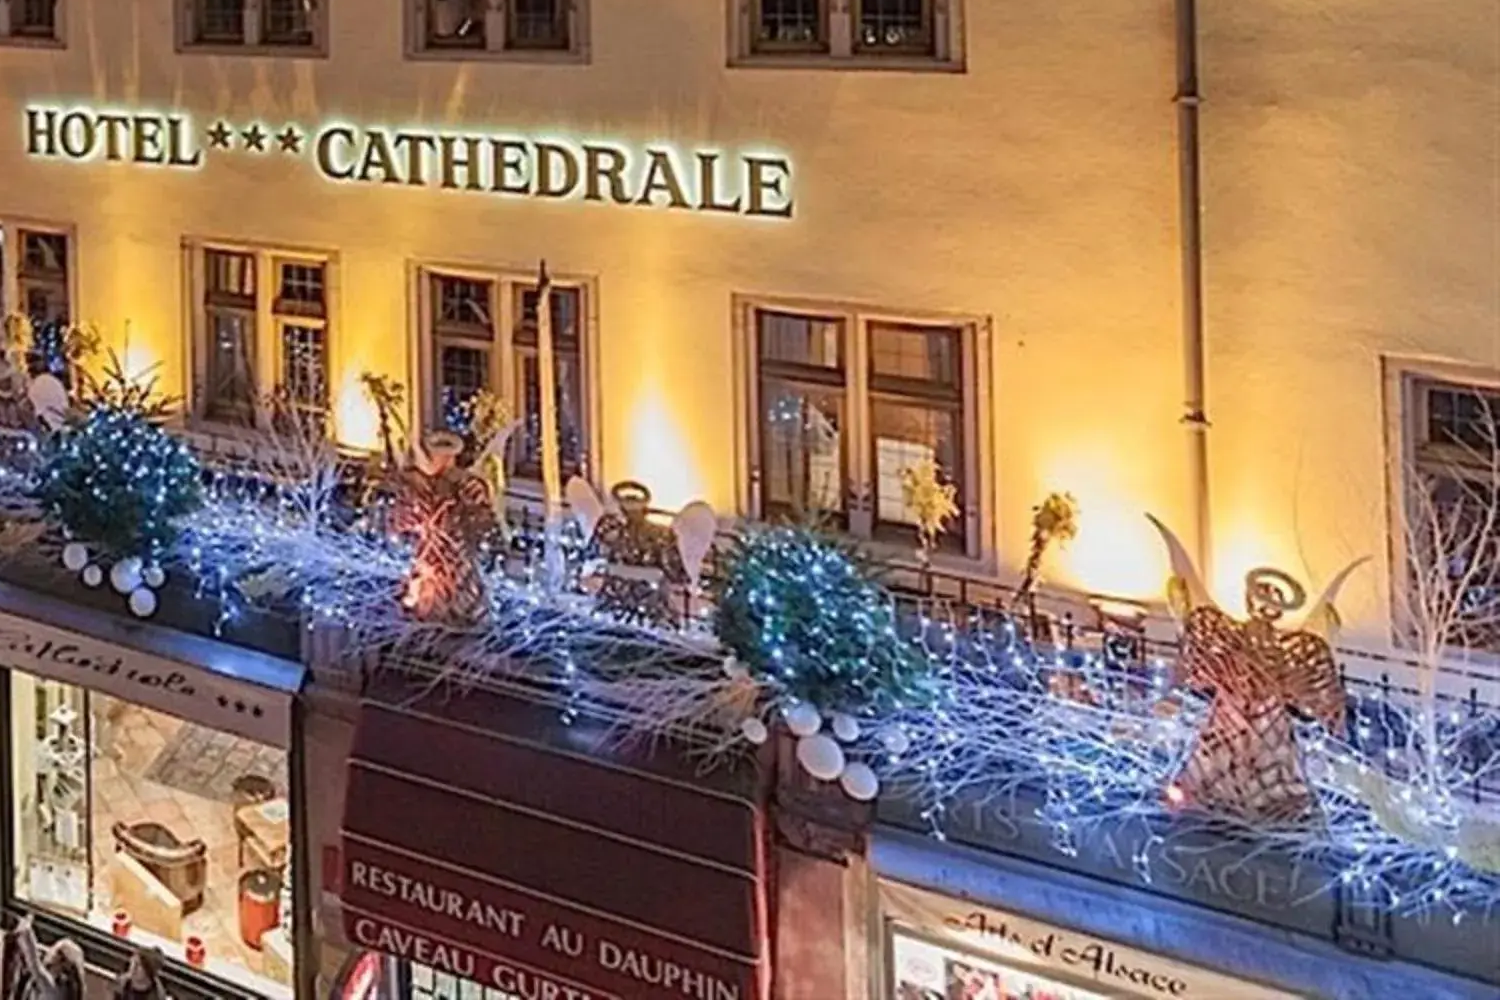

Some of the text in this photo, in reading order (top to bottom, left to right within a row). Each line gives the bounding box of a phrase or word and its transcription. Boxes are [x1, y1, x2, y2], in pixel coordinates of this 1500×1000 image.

[26, 108, 793, 218] HOTEL CATHEDRALE
[352, 861, 739, 1000] RESTAURANT AU DAUPHIN
[355, 919, 592, 1000] CAVEAU GURT
[943, 912, 1023, 943] Arts
